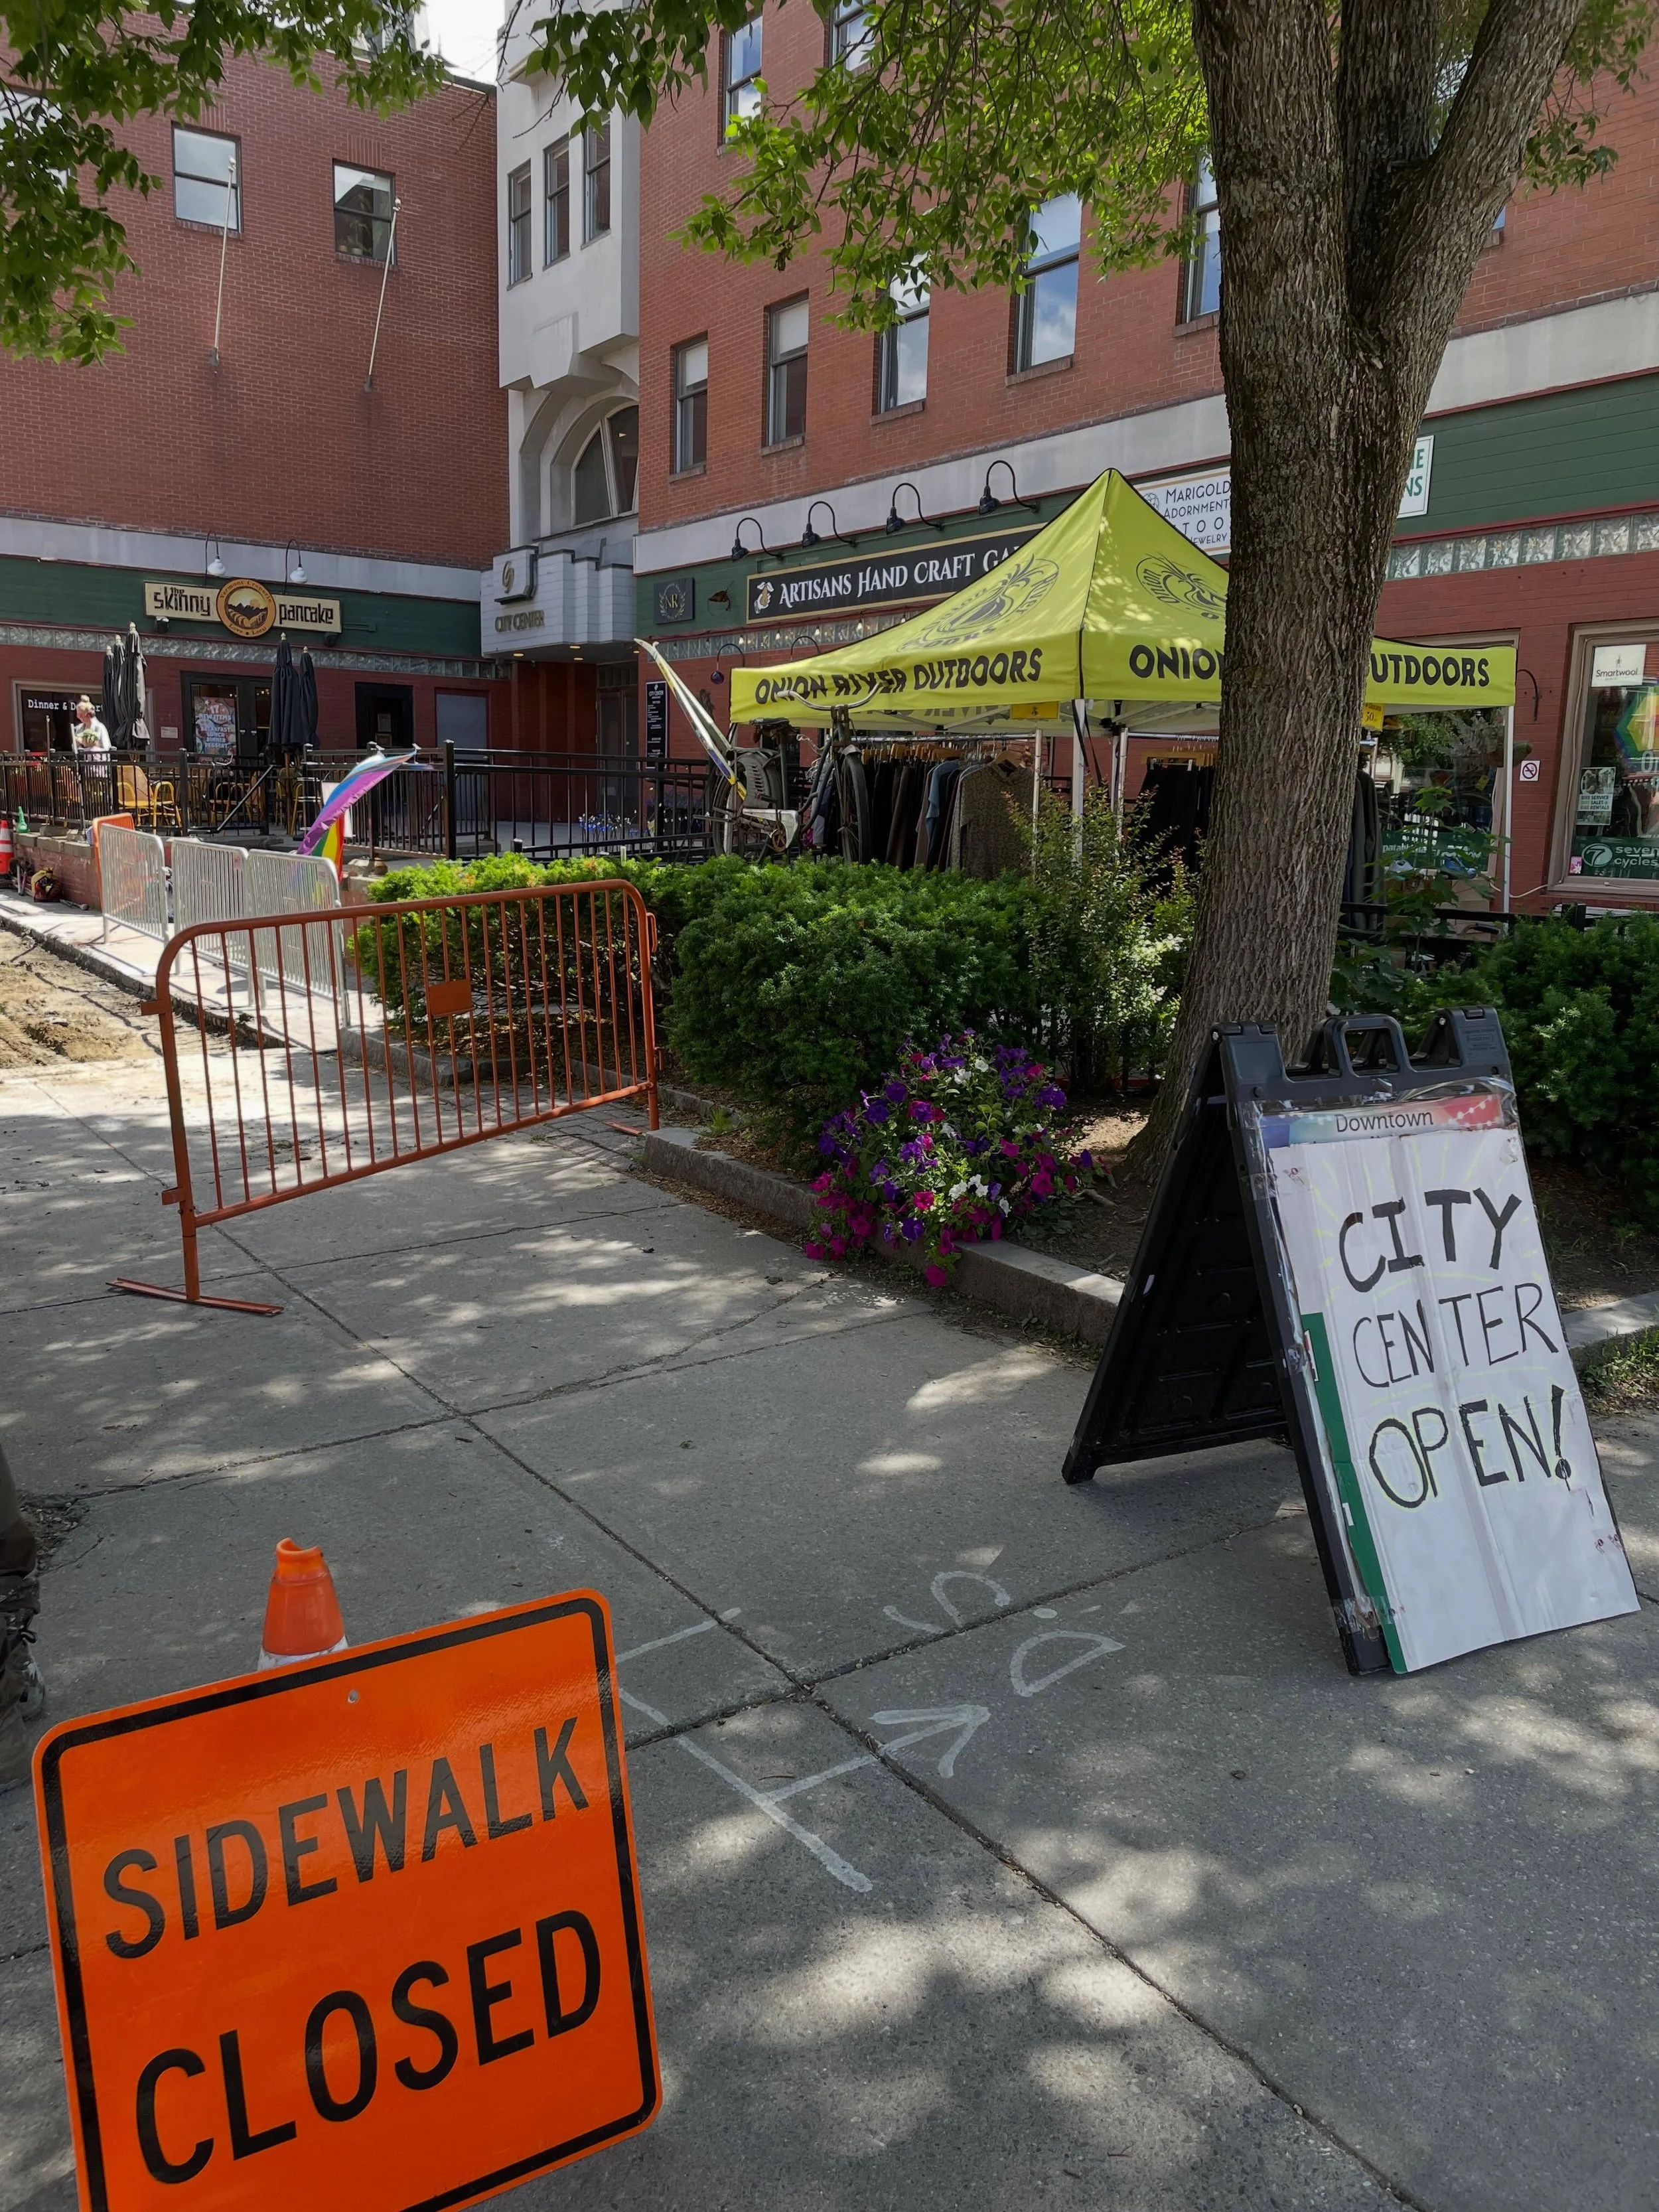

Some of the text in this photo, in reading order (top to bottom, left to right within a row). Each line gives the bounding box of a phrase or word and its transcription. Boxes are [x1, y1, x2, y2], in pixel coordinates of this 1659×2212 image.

[779, 573, 851, 608] ARTISANS
[857, 566, 908, 598] HAND
[914, 553, 975, 584] CRAFT
[153, 586, 334, 625] skinny pancake
[494, 609, 545, 632] CITY CENTER
[755, 676, 828, 704] ONION
[914, 648, 1043, 690] OUTDOORS
[1368, 653, 1490, 687] UTDOORS
[1596, 668, 1638, 678] Smartwool
[28, 699, 59, 710] Dinner
[1613, 857, 1659, 869] cycles
[1615, 846, 1659, 855] seven
[1336, 1111, 1433, 1133] Downtown
[1338, 1187, 1522, 1293] CITY
[1352, 1282, 1559, 1388] CENTER
[1368, 1384, 1571, 1509] OPEN!
[103, 1716, 589, 1959] SIDEWALK
[135, 1908, 602, 2185] CLOSED
